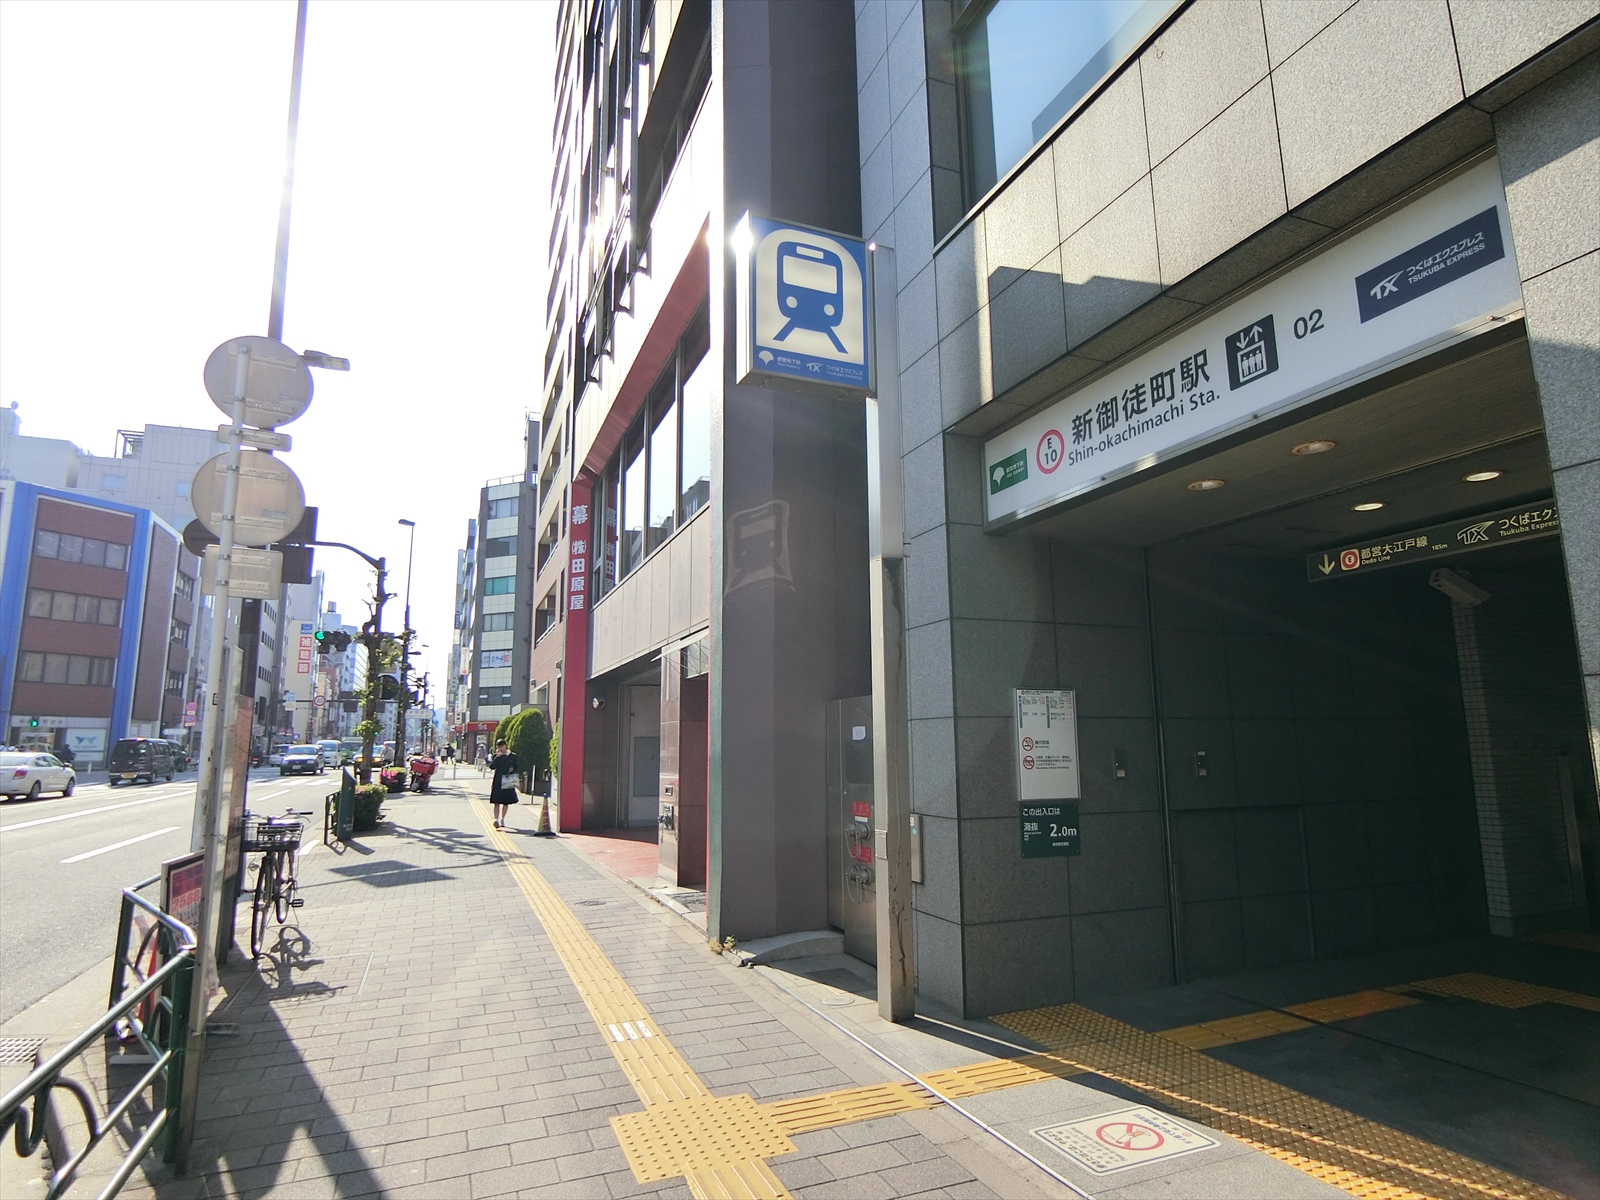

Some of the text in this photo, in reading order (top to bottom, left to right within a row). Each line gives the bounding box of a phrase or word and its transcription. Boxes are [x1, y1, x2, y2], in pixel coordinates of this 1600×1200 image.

[1406, 232, 1484, 276] つくばエクスプレス
[1407, 243, 1486, 284] TSUKUBA EXPRESS
[1370, 269, 1404, 301] TX
[1293, 308, 1325, 340] 02
[806, 362, 824, 373] TX
[1071, 348, 1211, 447] 新御徒町駅
[1068, 389, 1220, 466] Shin-okachimachi Sta.
[1047, 437, 1053, 449] E
[1044, 449, 1058, 465] 10
[572, 504, 589, 525] 幕
[1499, 526, 1530, 537] Tsukuba
[1360, 535, 1428, 560] 都営大江戸線
[1022, 807, 1061, 817] この出入口は
[1049, 823, 1077, 837] 2.0m
